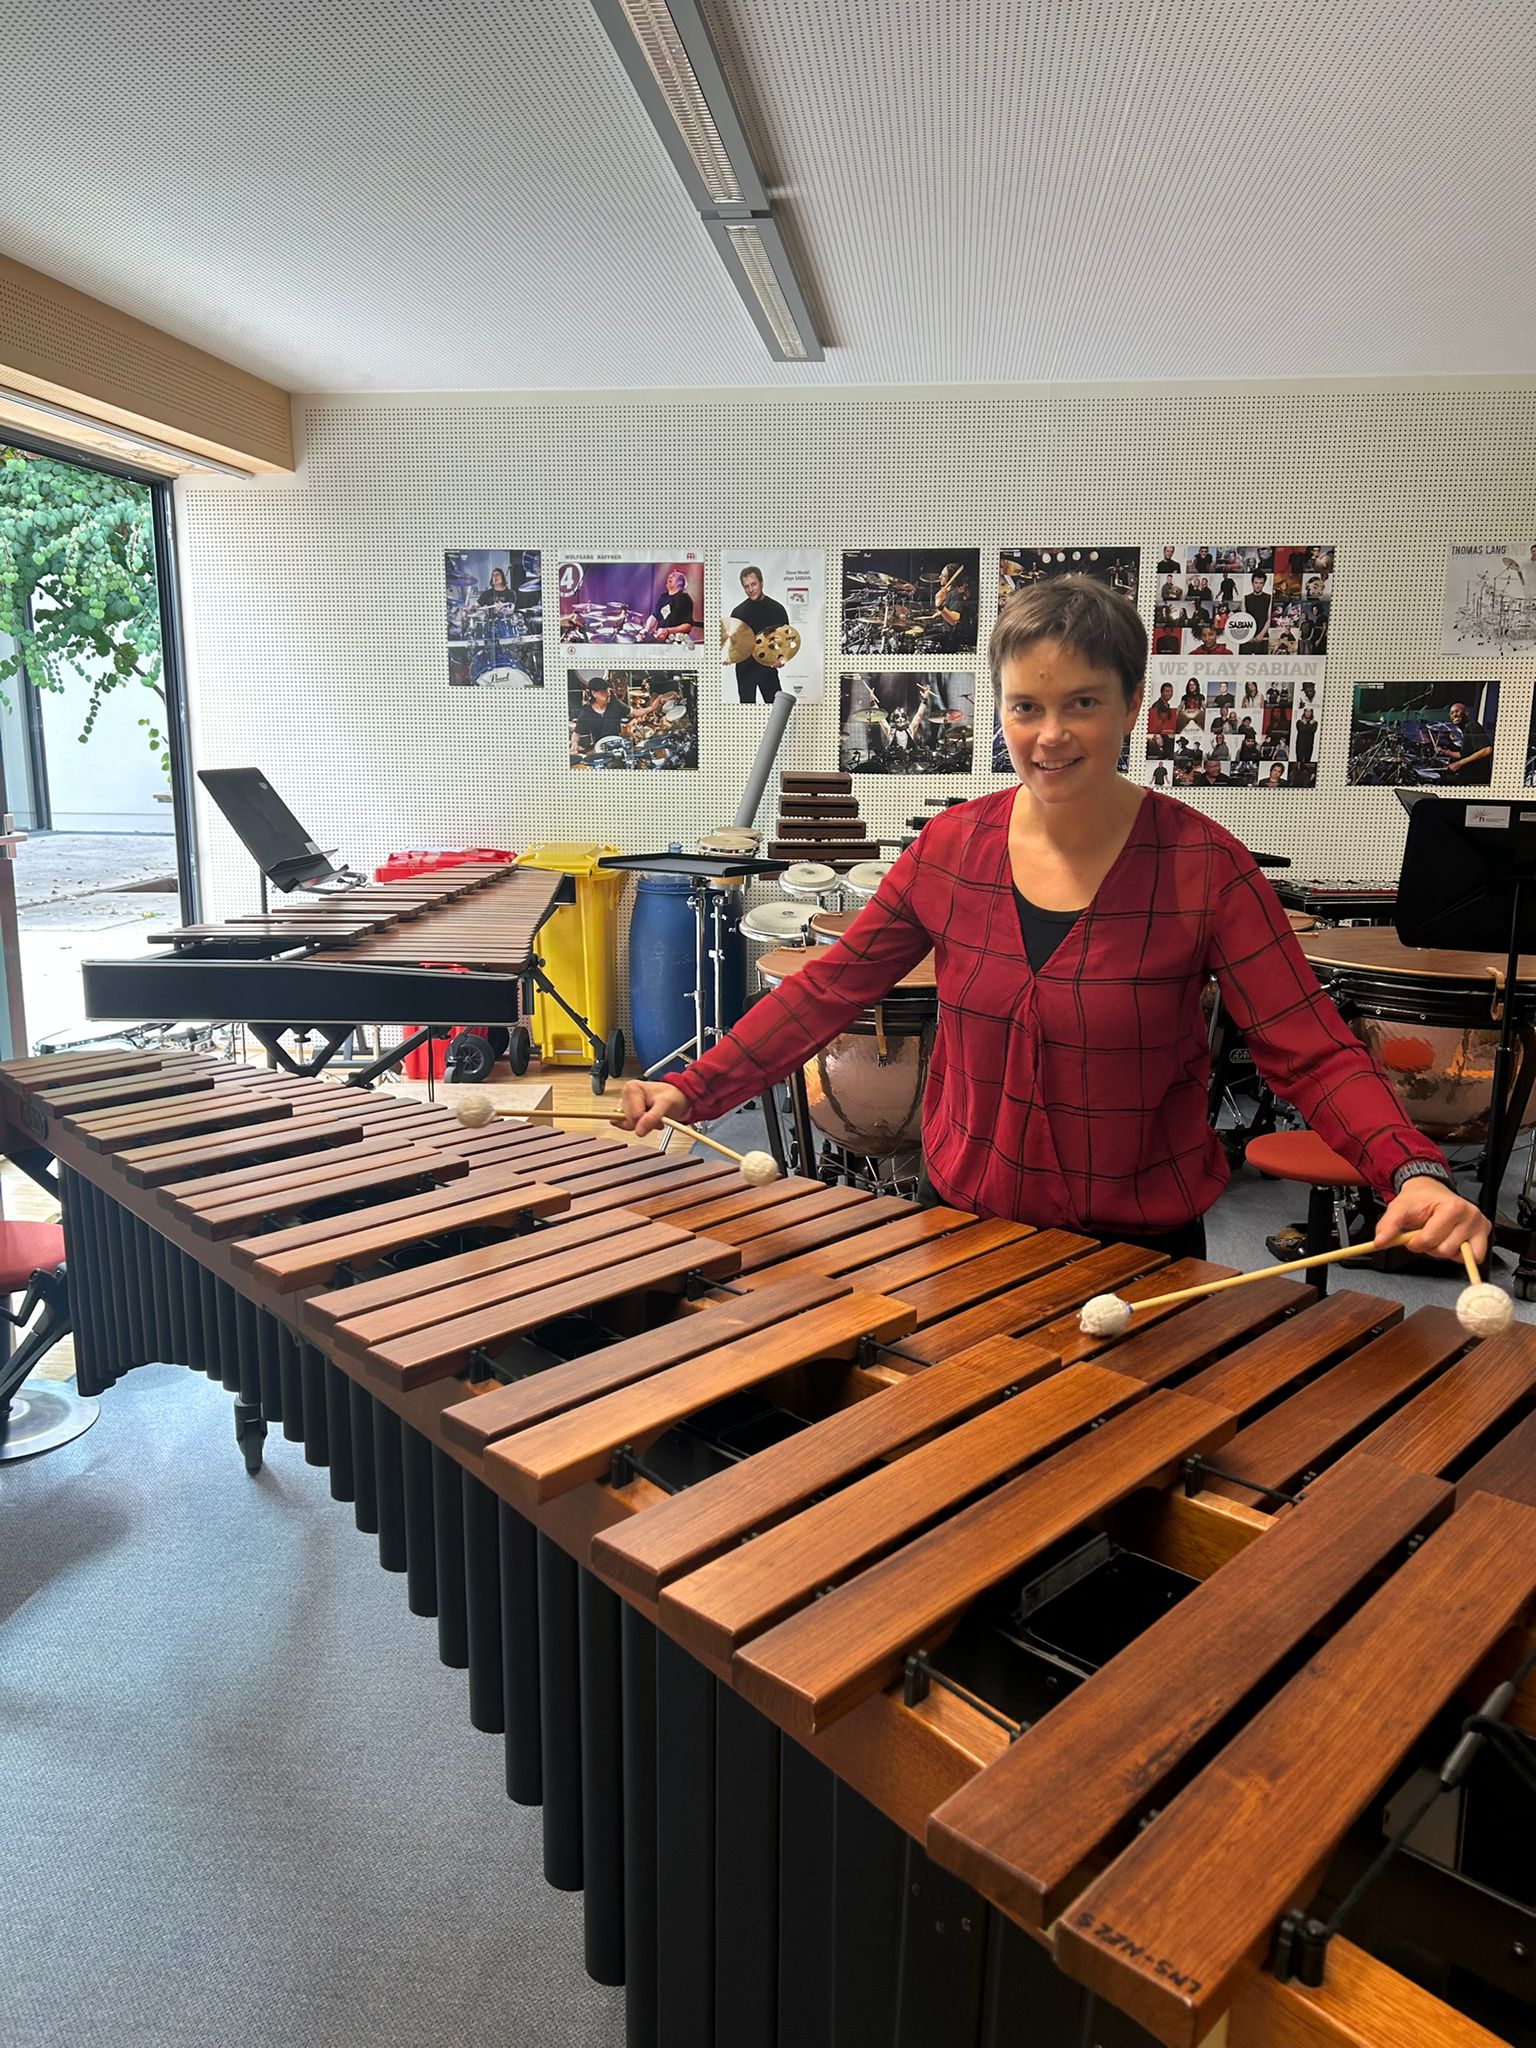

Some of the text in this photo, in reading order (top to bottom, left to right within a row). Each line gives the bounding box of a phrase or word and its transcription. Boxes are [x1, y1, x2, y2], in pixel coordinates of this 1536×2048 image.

[1452, 545, 1483, 555] THOMAS
[1485, 545, 1507, 555] LANG
[561, 567, 574, 589] 4
[1228, 621, 1253, 629] SABIAN
[1159, 662, 1318, 676] WE PLAY SABIAN
